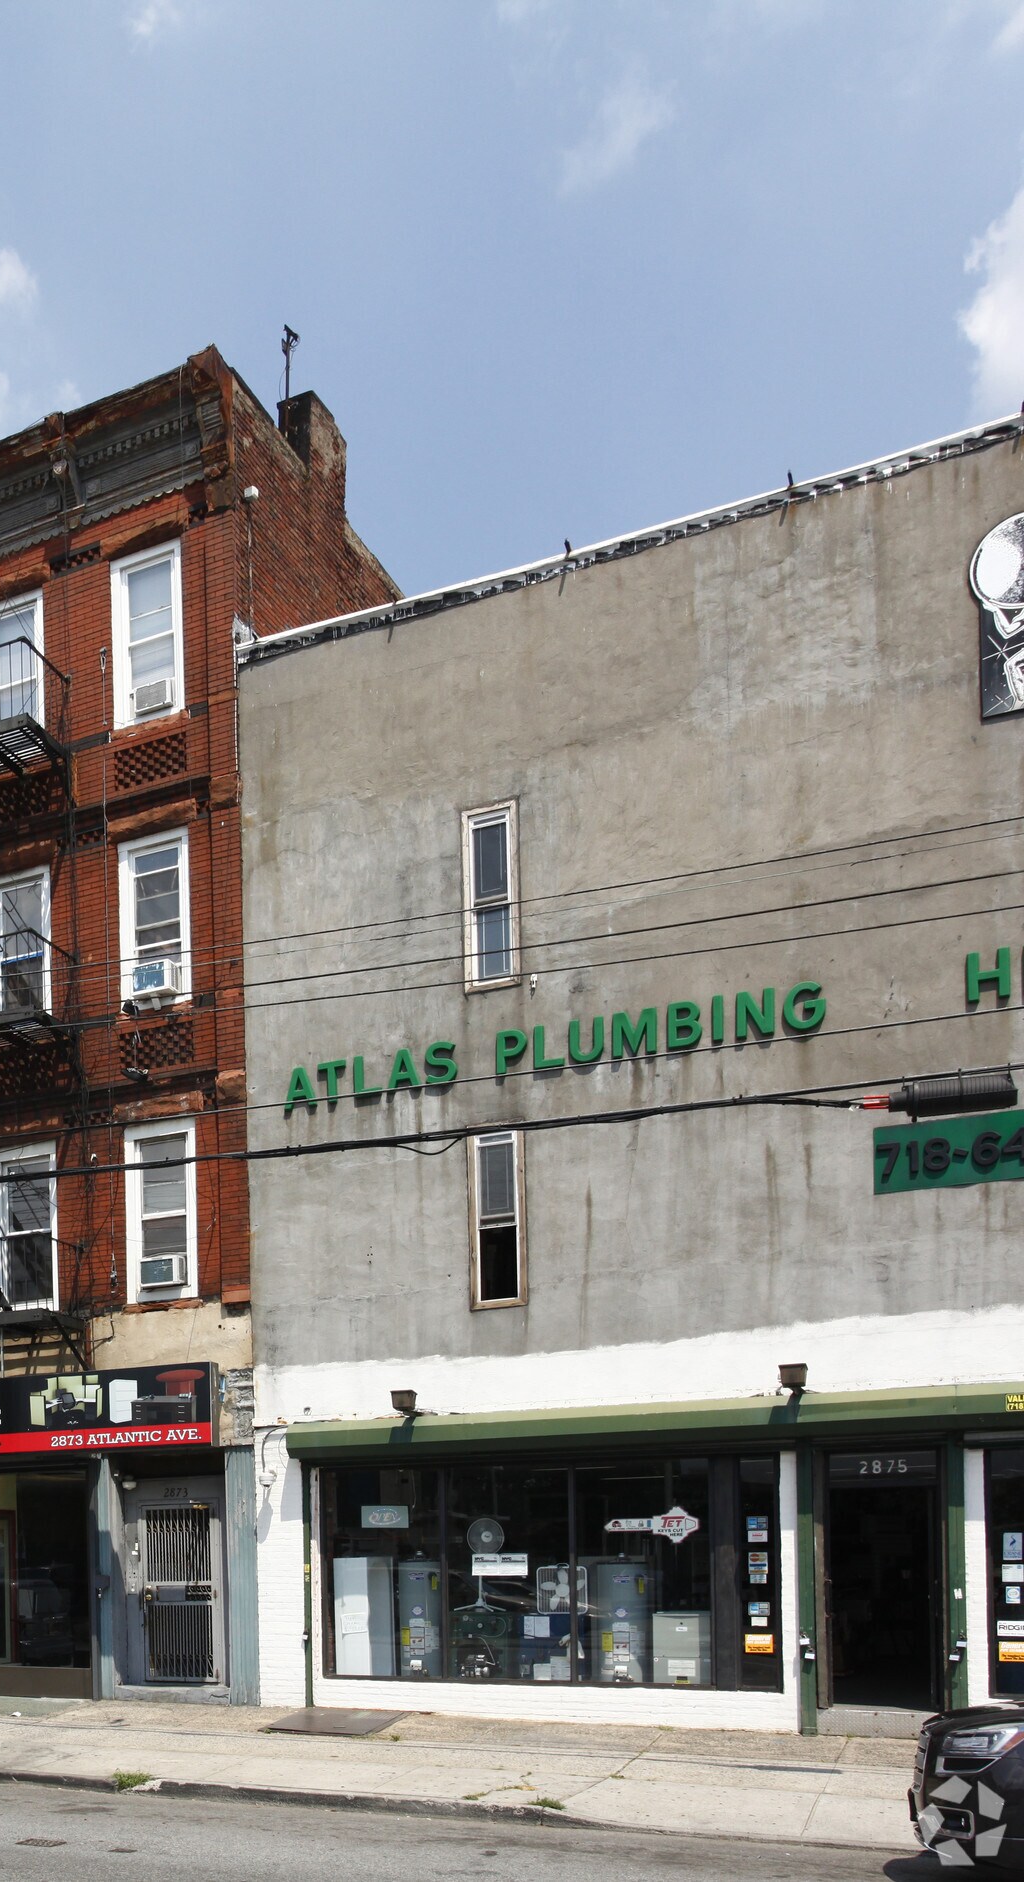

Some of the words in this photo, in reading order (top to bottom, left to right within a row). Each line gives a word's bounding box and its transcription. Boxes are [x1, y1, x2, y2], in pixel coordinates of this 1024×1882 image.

[283, 1041, 459, 1111] ATLAS
[495, 981, 829, 1075] PLUMBING
[966, 946, 1024, 1004] H
[50, 1435, 84, 1447] 2873
[86, 1430, 162, 1445] ATLANTIC
[166, 1428, 202, 1441] AVE.
[859, 1459, 908, 1474] 2875
[163, 1487, 189, 1498] 2873
